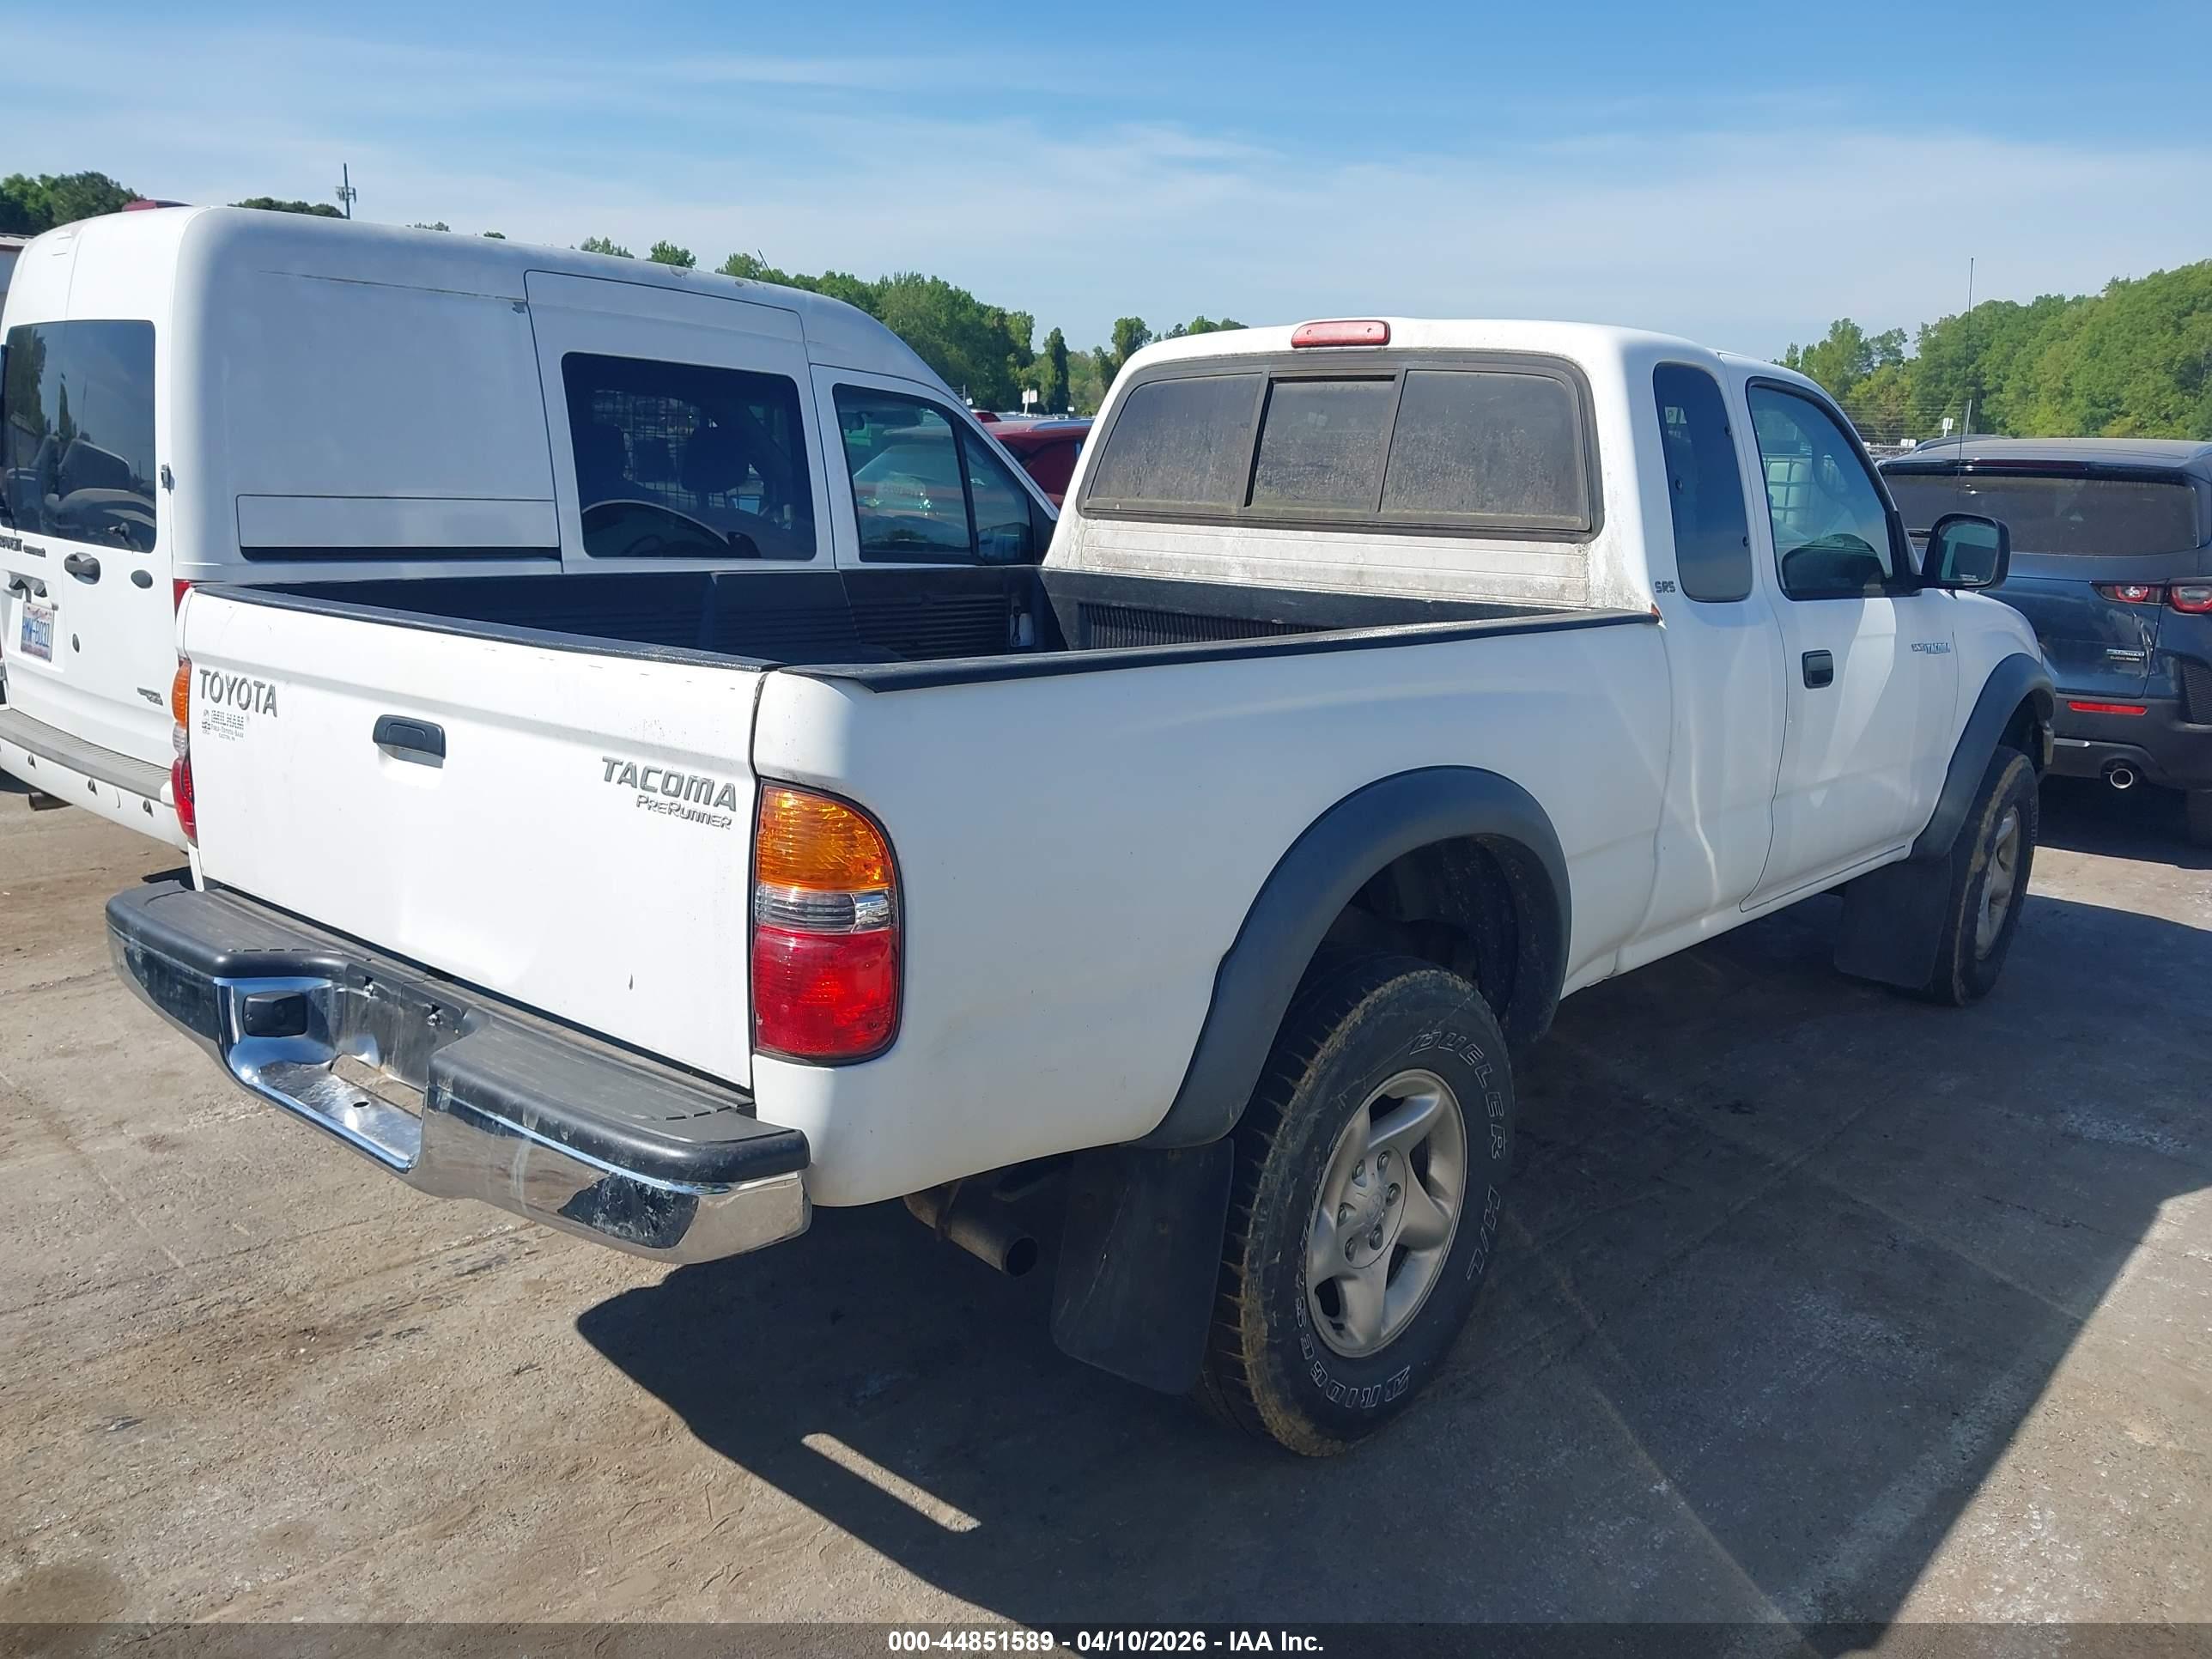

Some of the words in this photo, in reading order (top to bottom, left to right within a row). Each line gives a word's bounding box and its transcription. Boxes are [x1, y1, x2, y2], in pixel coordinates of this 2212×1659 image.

[199, 668, 277, 718] TOYOTA
[602, 756, 737, 811] TACOMA
[1409, 1030, 1505, 1159] DUELER
